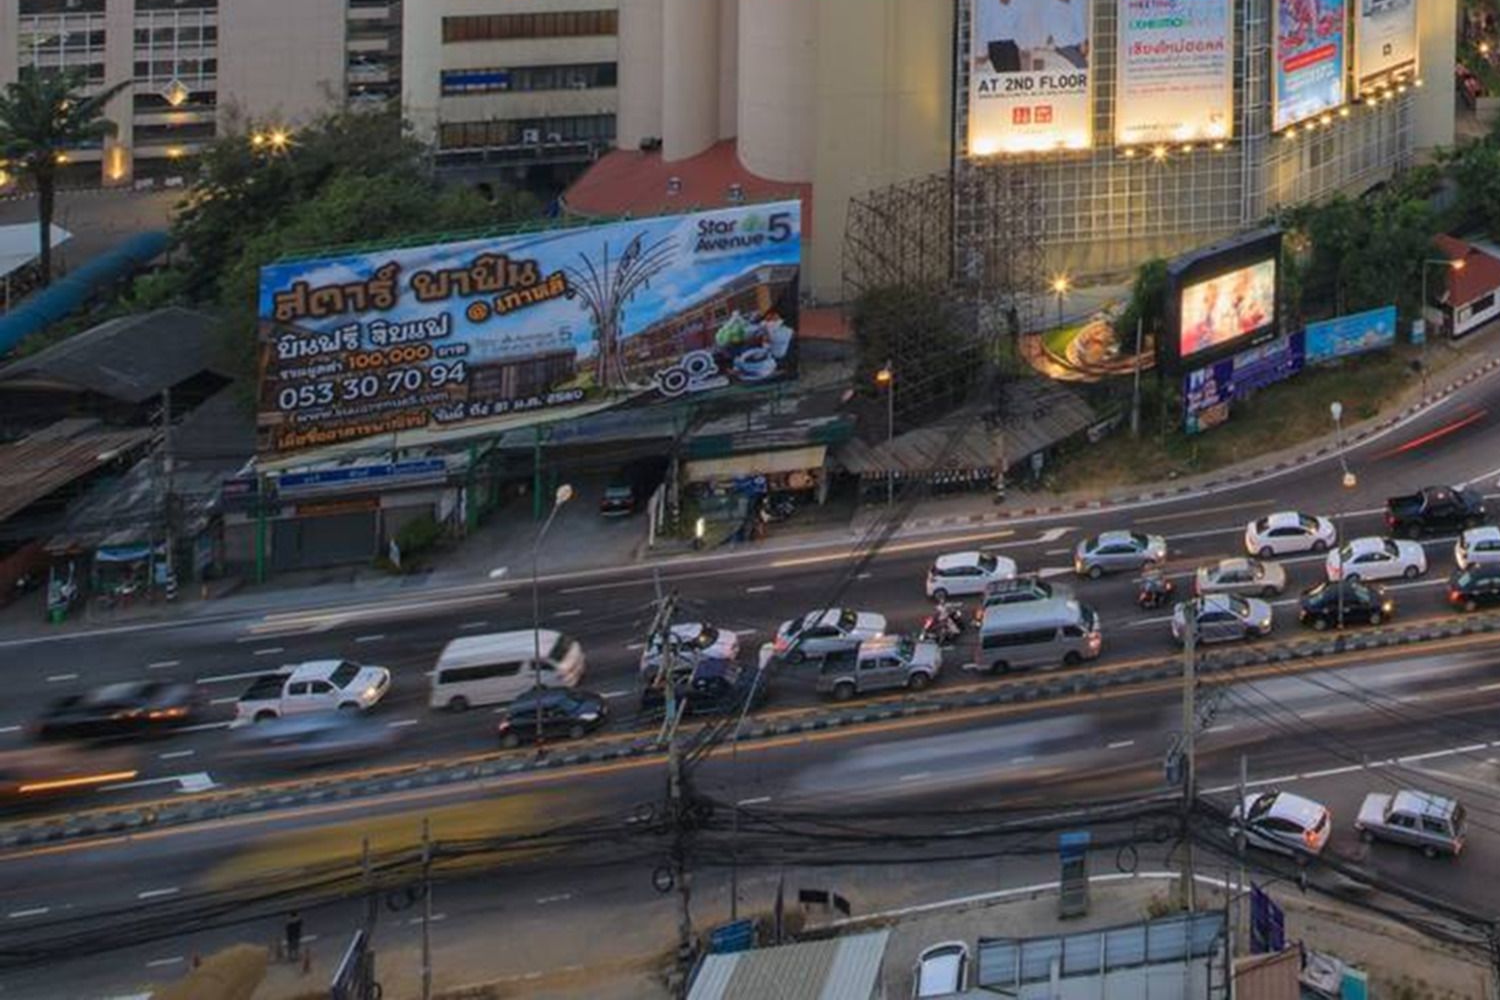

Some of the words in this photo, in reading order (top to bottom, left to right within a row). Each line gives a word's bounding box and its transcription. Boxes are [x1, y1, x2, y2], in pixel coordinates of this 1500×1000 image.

[979, 78, 998, 92] AT
[1005, 76, 1034, 91] 2ND
[1040, 73, 1087, 89] FLOOR
[694, 234, 764, 253] Avenue
[697, 219, 737, 237] Star
[768, 212, 791, 242] 5
[275, 261, 399, 321] สตาร์
[277, 323, 360, 360] บินฟรี
[279, 381, 335, 410] 053
[344, 375, 379, 400] 30
[387, 369, 422, 393] 70
[431, 362, 467, 386] 94
